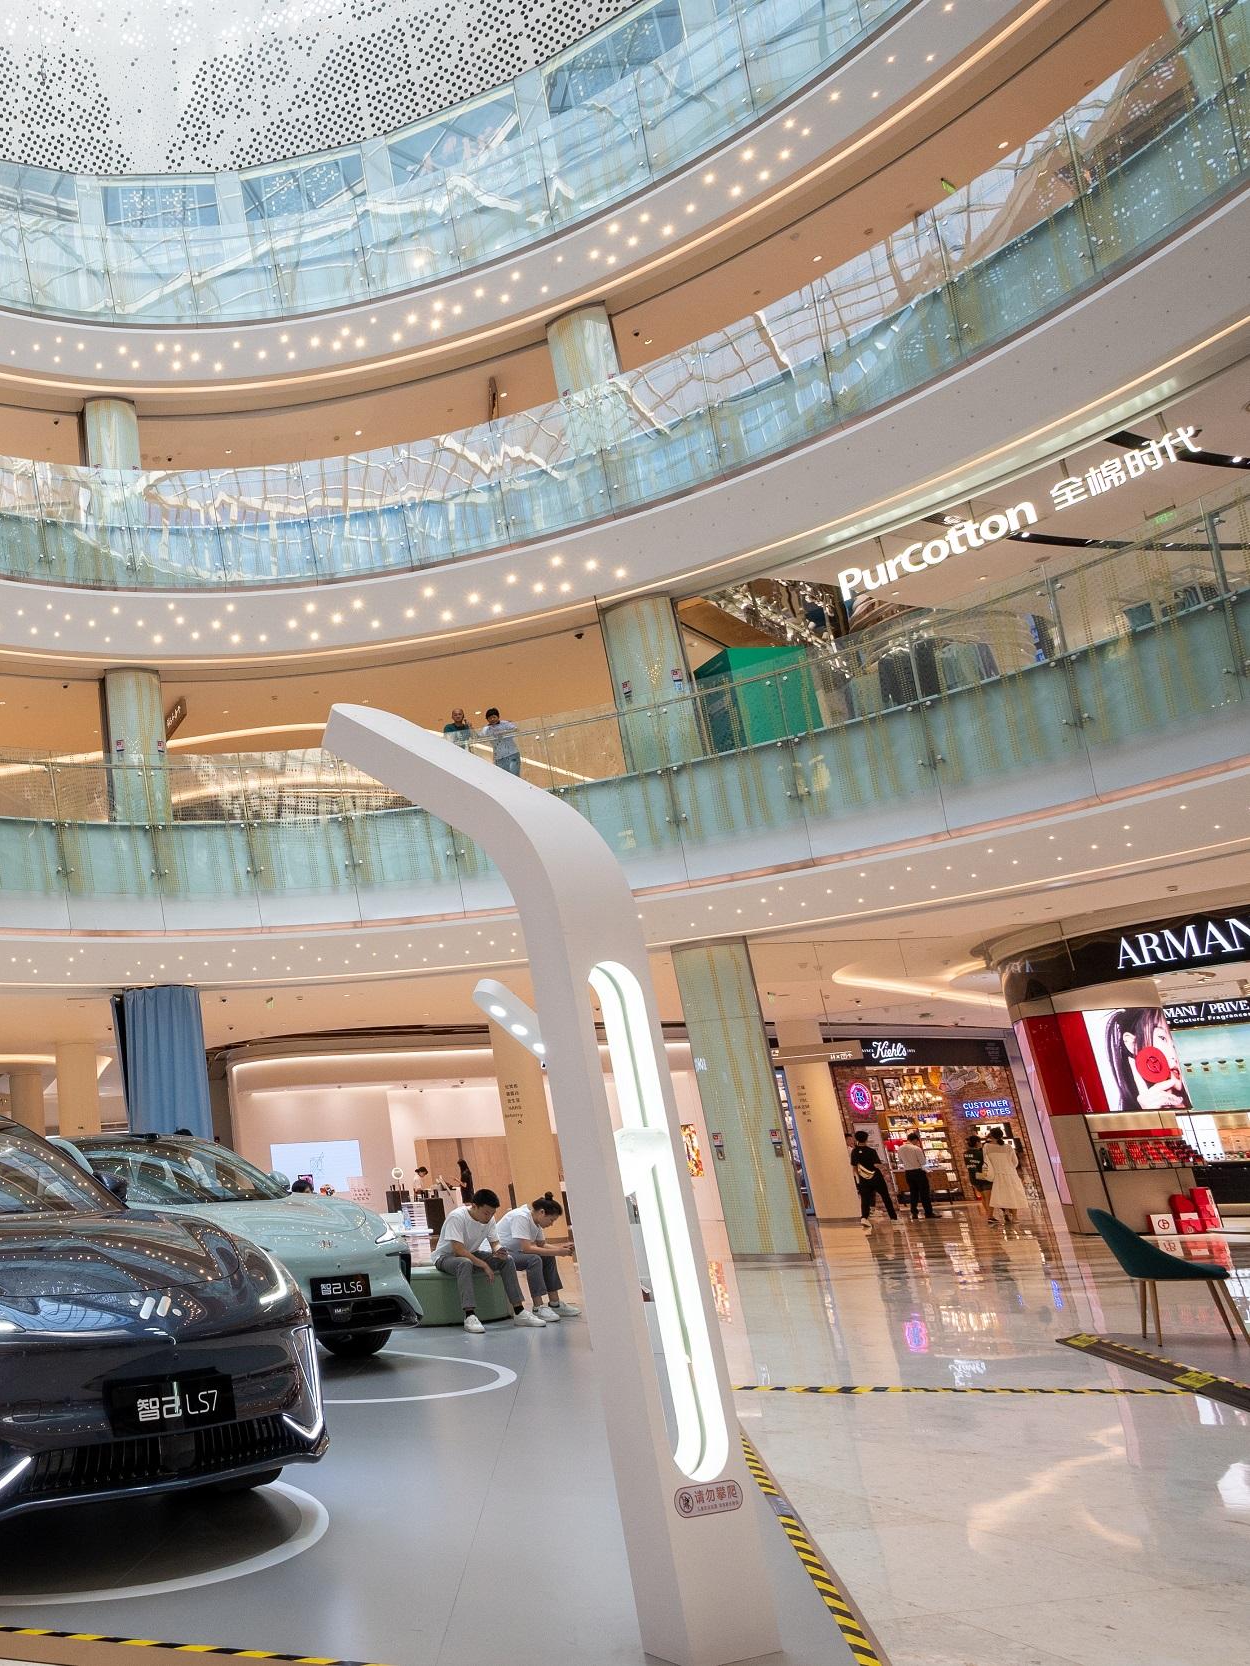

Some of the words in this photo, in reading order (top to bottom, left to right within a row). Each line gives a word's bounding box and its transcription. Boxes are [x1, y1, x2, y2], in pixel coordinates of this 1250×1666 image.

[1050, 425, 1202, 511] 全棉时代
[871, 1041, 907, 1059] Kiehl's
[962, 1099, 1009, 1110] CUSTOMER
[694, 1485, 738, 1504] 请勿攀爬
